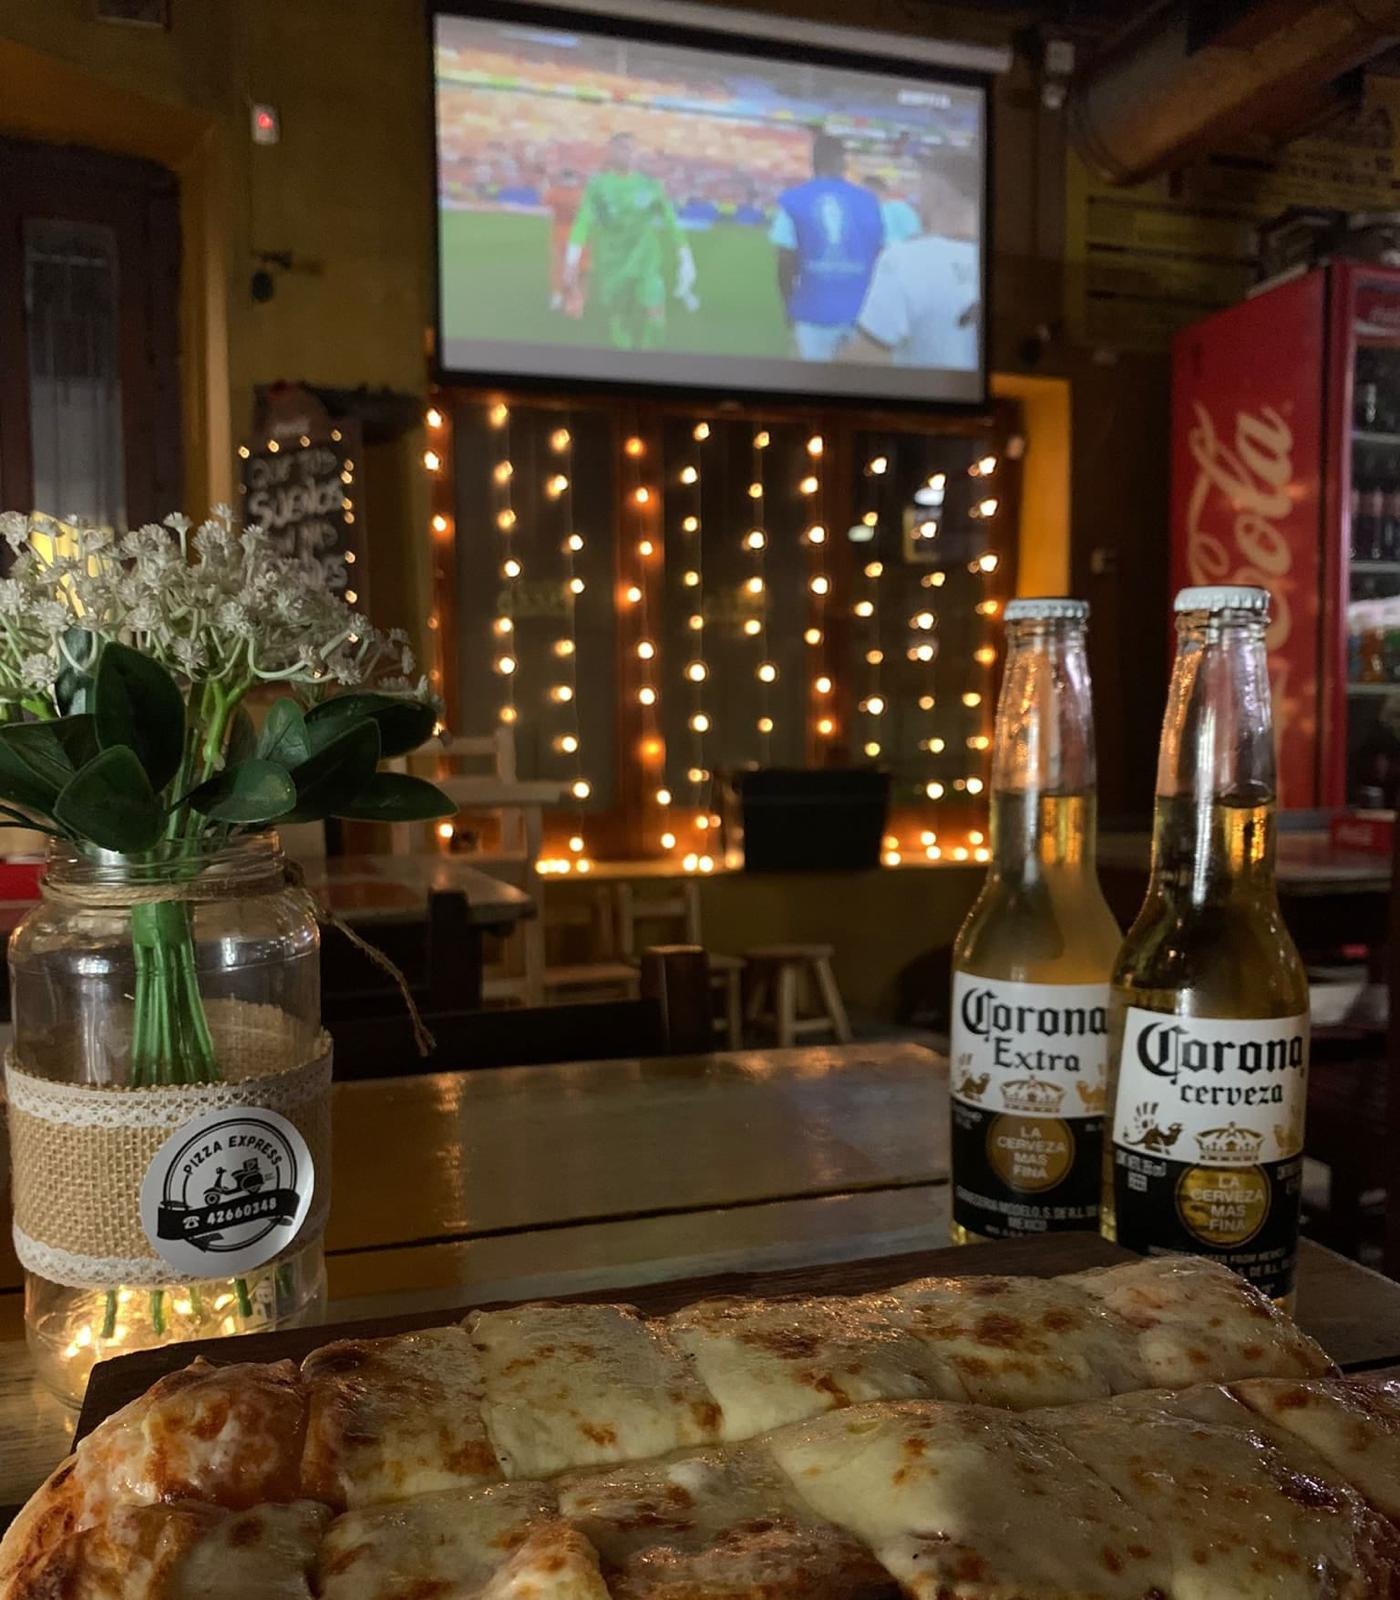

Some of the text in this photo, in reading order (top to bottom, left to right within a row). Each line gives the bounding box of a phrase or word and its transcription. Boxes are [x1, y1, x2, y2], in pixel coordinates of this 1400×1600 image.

[961, 987, 1108, 1042] Corona
[994, 1037, 1080, 1072] Extra
[1137, 1022, 1303, 1085] Corona
[1180, 1084, 1283, 1106] cerveza
[1021, 1126, 1042, 1139] LA
[997, 1136, 1066, 1152] CERVEZA
[183, 1135, 282, 1175] PIZZA EXPRESS
[1219, 1174, 1239, 1189] LA
[1190, 1189, 1264, 1203] CERVEZA
[207, 1197, 277, 1225] 42660348
[1211, 1204, 1246, 1217] MAS
[1209, 1218, 1246, 1232] FINA
